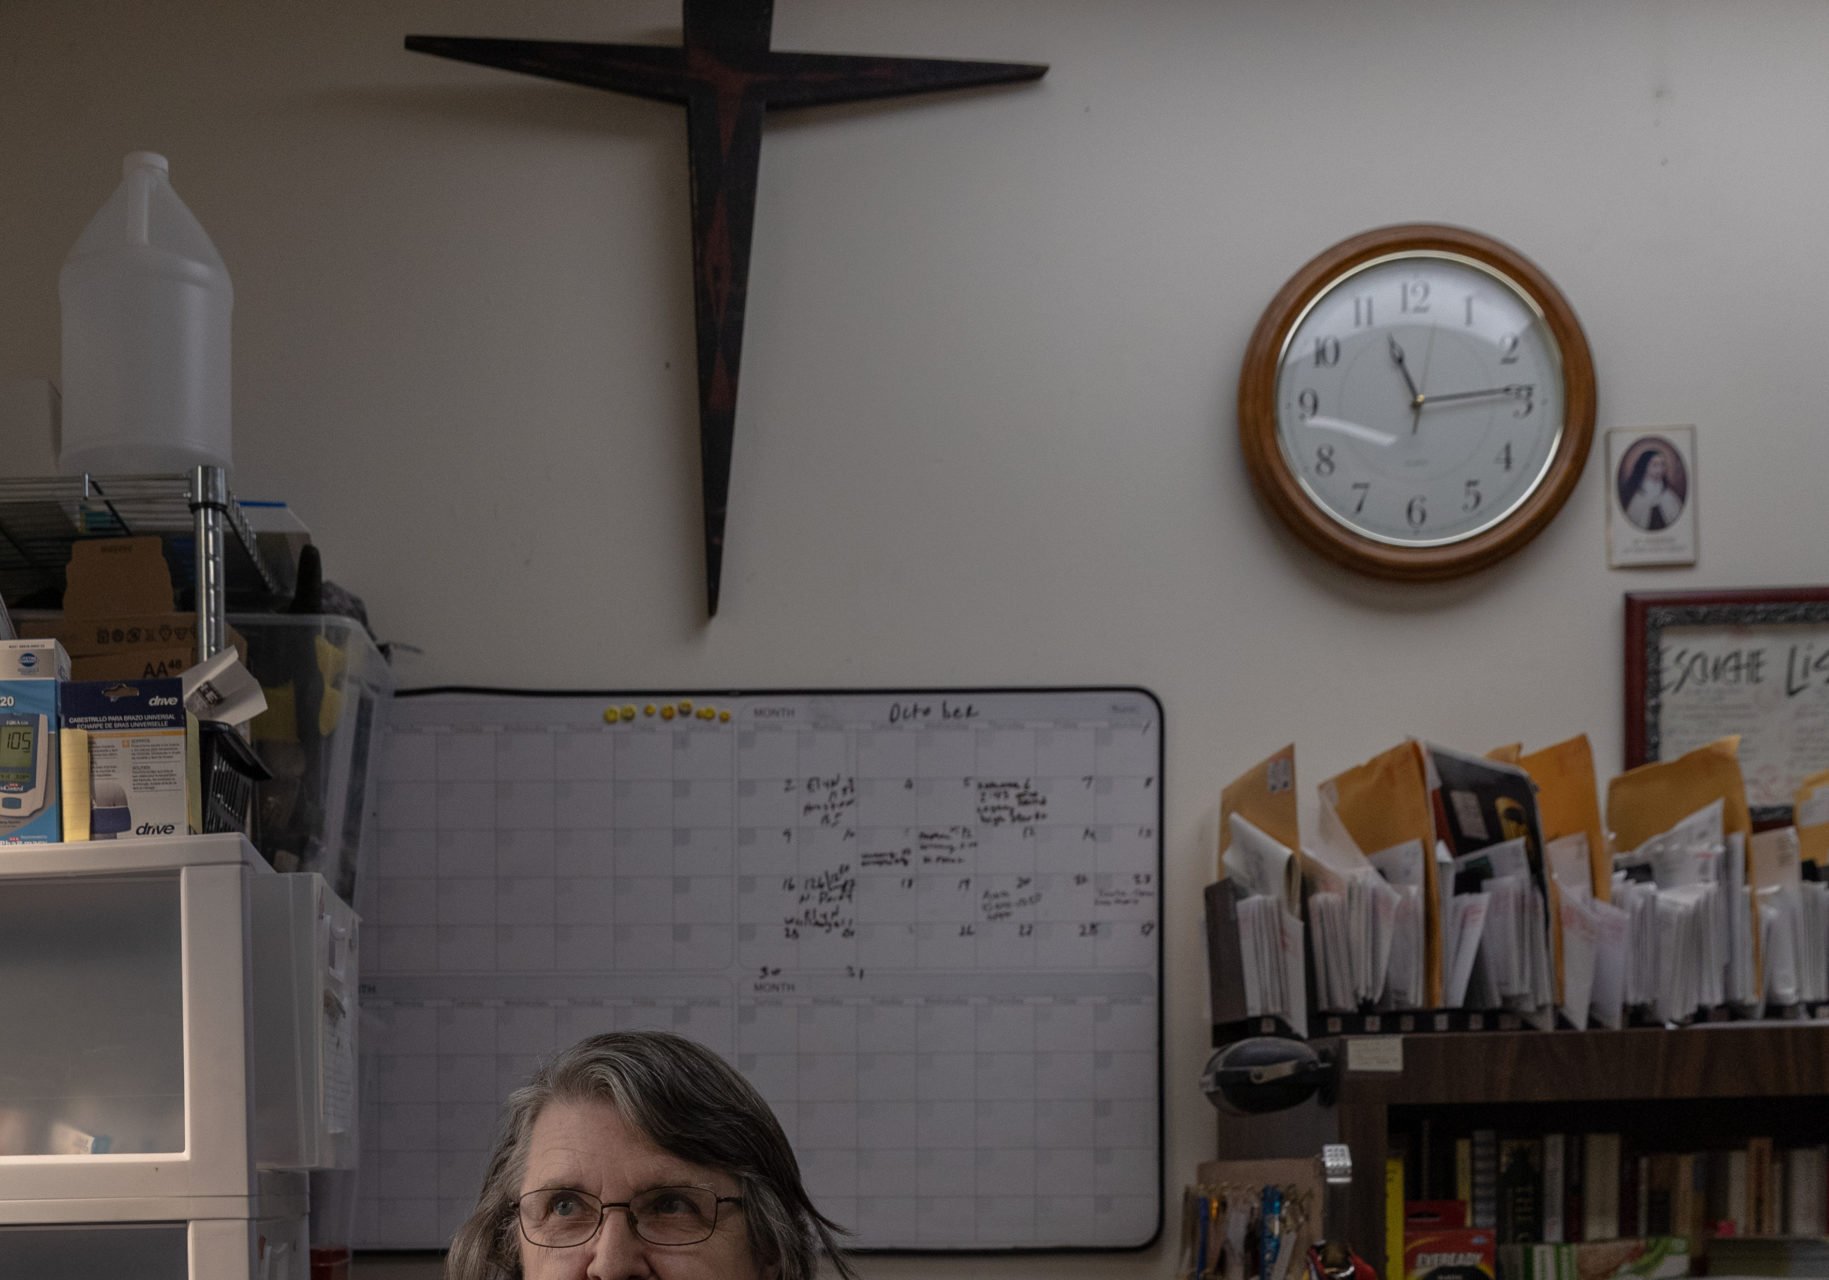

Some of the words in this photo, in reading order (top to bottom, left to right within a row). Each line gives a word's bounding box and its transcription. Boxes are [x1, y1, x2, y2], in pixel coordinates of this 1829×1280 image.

[1353, 296, 1374, 327] 11
[1401, 281, 1430, 313] 12
[1464, 296, 1473, 326] 1
[1313, 336, 1340, 368] 10
[1499, 334, 1519, 363] 2
[1299, 388, 1318, 420] 9
[1512, 384, 1534, 417] 3
[1315, 444, 1335, 476] 8
[1495, 442, 1512, 471] 4
[1351, 483, 1370, 514] 7
[1462, 480, 1482, 511] 5
[1407, 495, 1426, 528] 6
[148, 695, 178, 707] drive
[753, 707, 795, 719] MONTH
[131, 720, 168, 728] UNIVERSELLE
[6, 731, 31, 750] 105
[136, 823, 175, 836] drive
[753, 982, 795, 993] MONTH
[1416, 1252, 1485, 1267] EVEREADY
